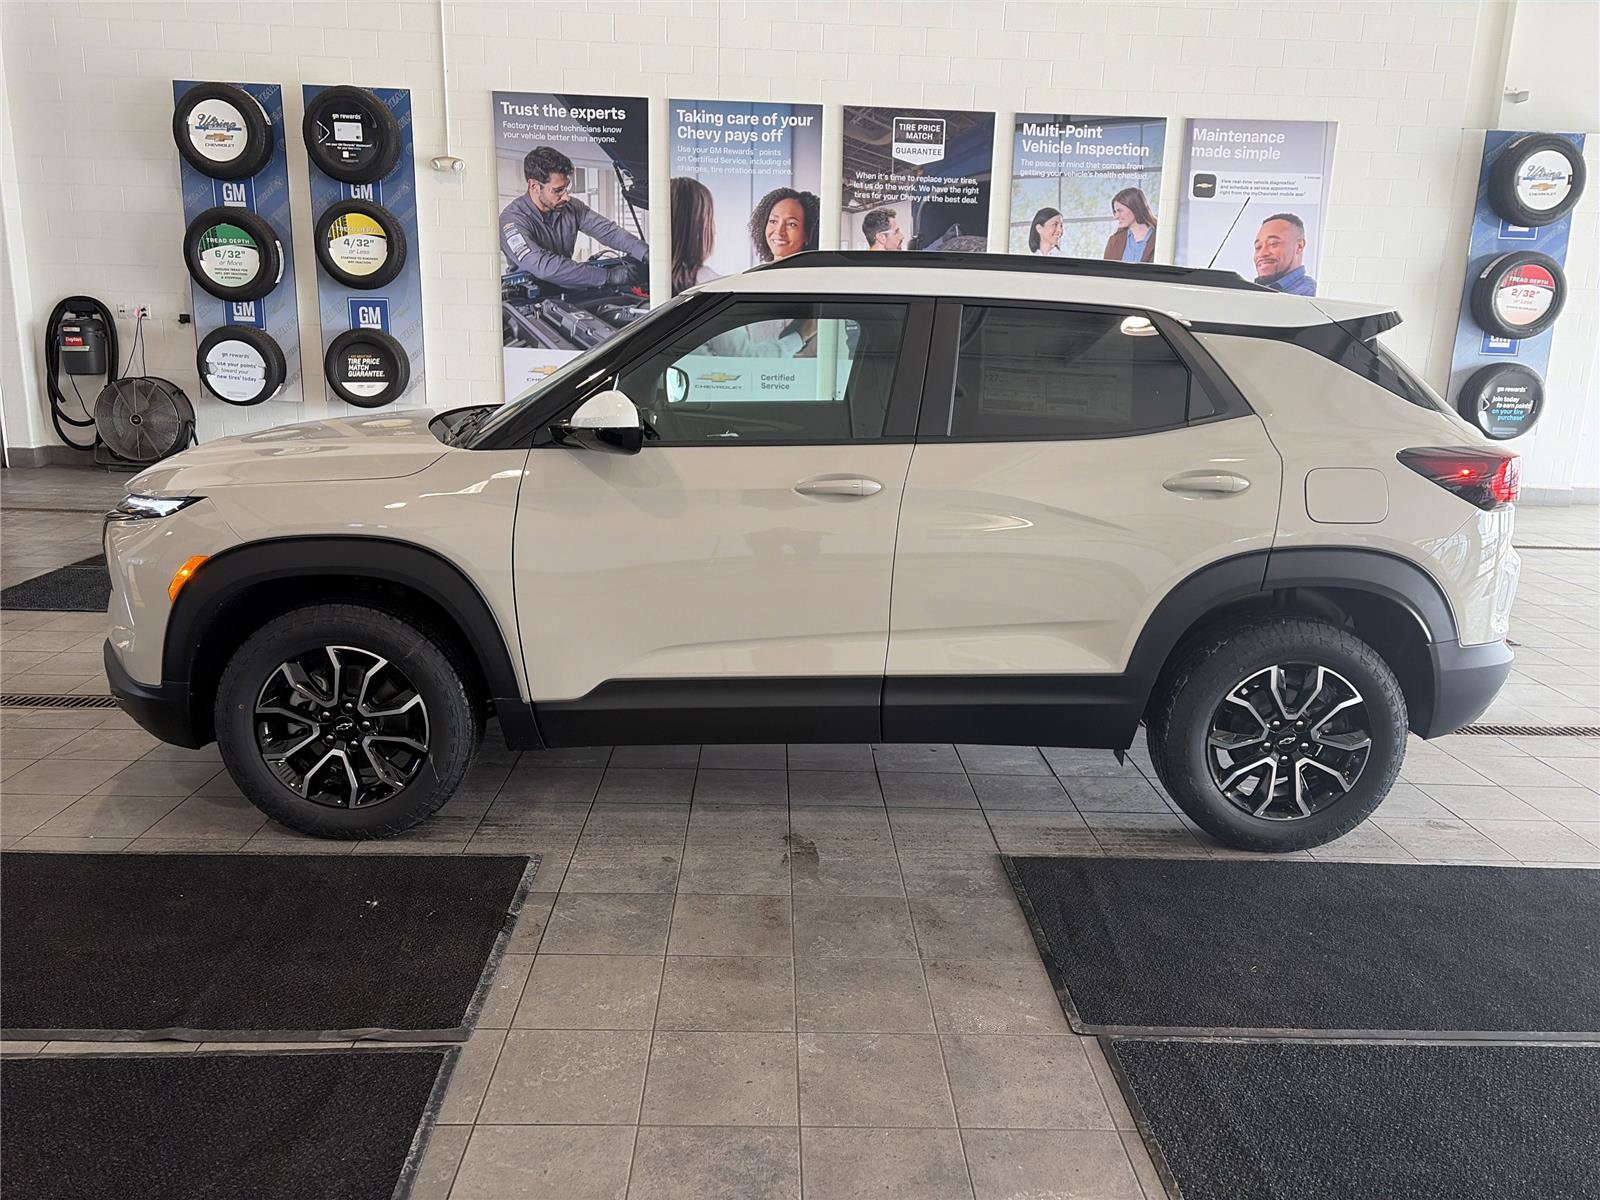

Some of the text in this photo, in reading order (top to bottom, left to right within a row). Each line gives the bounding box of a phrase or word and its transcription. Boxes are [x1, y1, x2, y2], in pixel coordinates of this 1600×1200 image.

[500, 101, 626, 122] Trust the experts
[676, 109, 814, 129] Taking care of your
[502, 121, 622, 134] Factory-trained technicians know
[900, 123, 941, 133] TIRE PRICE
[1022, 122, 1103, 139] Multi-Point
[520, 132, 546, 141] vehicle
[547, 133, 570, 141] better
[571, 134, 588, 142] than
[589, 136, 617, 144] anyone.
[677, 126, 784, 144] Chevy pays off
[906, 132, 933, 140] MATCH
[1193, 128, 1285, 144] Maintenance
[677, 145, 690, 153] Use
[710, 146, 723, 154] GM
[760, 149, 782, 157] points
[895, 147, 942, 156] GUARANTEE
[1022, 139, 1150, 158] Vehicle Inspection
[1191, 145, 1281, 162] made simple
[688, 155, 718, 164] Certified
[720, 158, 747, 166] Service,
[751, 158, 781, 167] including
[782, 158, 791, 166] oil
[1021, 159, 1034, 167] The
[1034, 160, 1056, 168] peace
[1066, 161, 1084, 169] mind
[1086, 161, 1100, 169] that
[677, 165, 708, 175] changes,
[711, 166, 723, 174] tire
[724, 167, 755, 175] rotations
[772, 168, 793, 176] more.
[1020, 169, 1045, 178] getting
[1094, 171, 1116, 179] health
[855, 172, 876, 180] When
[916, 176, 942, 184] replace
[943, 177, 960, 185] your
[223, 183, 246, 201] GM
[350, 184, 373, 200] GM
[853, 181, 863, 189] let
[874, 182, 884, 190] do
[919, 184, 930, 192] We
[949, 186, 961, 194] the
[962, 186, 979, 195] right
[854, 191, 870, 199] tires
[872, 191, 882, 199] for
[900, 193, 922, 202] Chevy
[344, 238, 374, 248] 4/32"
[215, 250, 245, 260] 6/32"
[1511, 288, 1540, 298] 2/32"
[233, 302, 255, 317] GM
[358, 306, 381, 324] GM
[761, 374, 795, 382] Certified
[761, 382, 790, 390] Service
